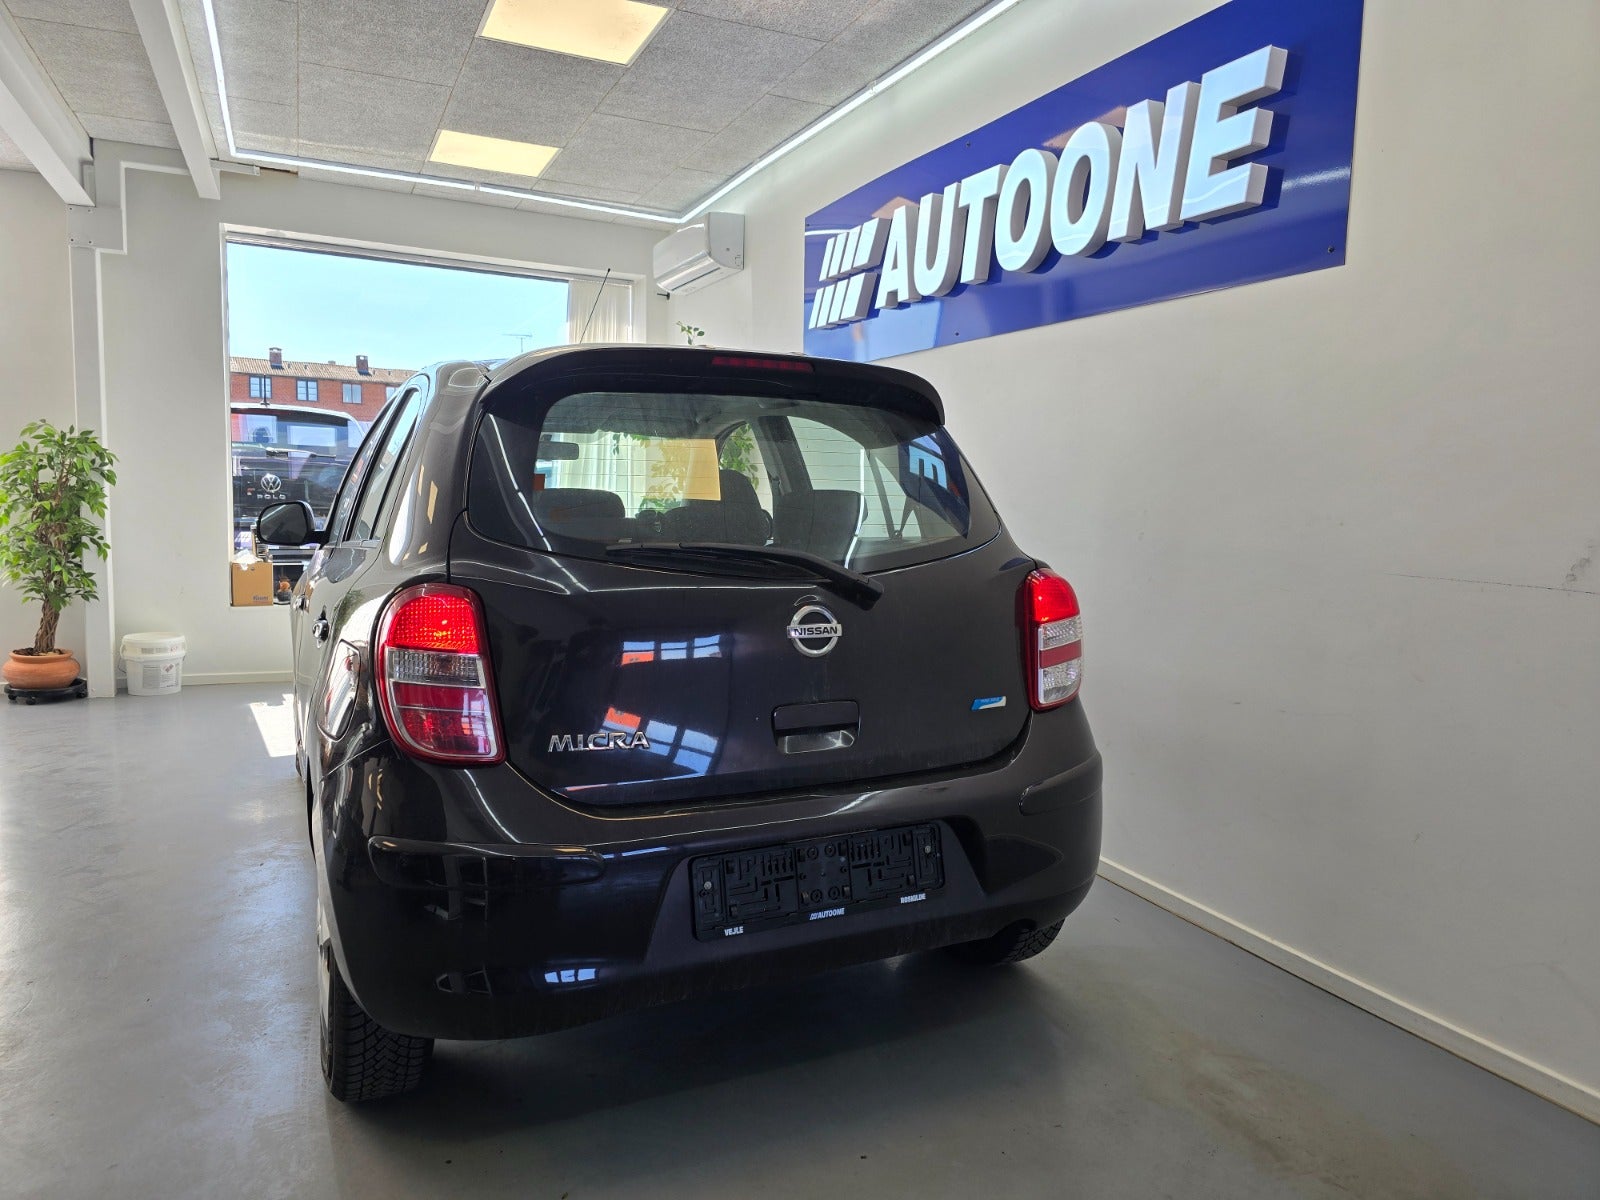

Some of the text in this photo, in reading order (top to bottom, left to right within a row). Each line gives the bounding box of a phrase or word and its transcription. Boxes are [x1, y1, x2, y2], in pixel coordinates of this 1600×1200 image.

[875, 45, 1288, 309] AUTOONE
[794, 626, 838, 636] NISSAN
[548, 731, 650, 752] MICRA
[818, 908, 845, 919] AUTOONE
[724, 926, 744, 936] VEJLE
